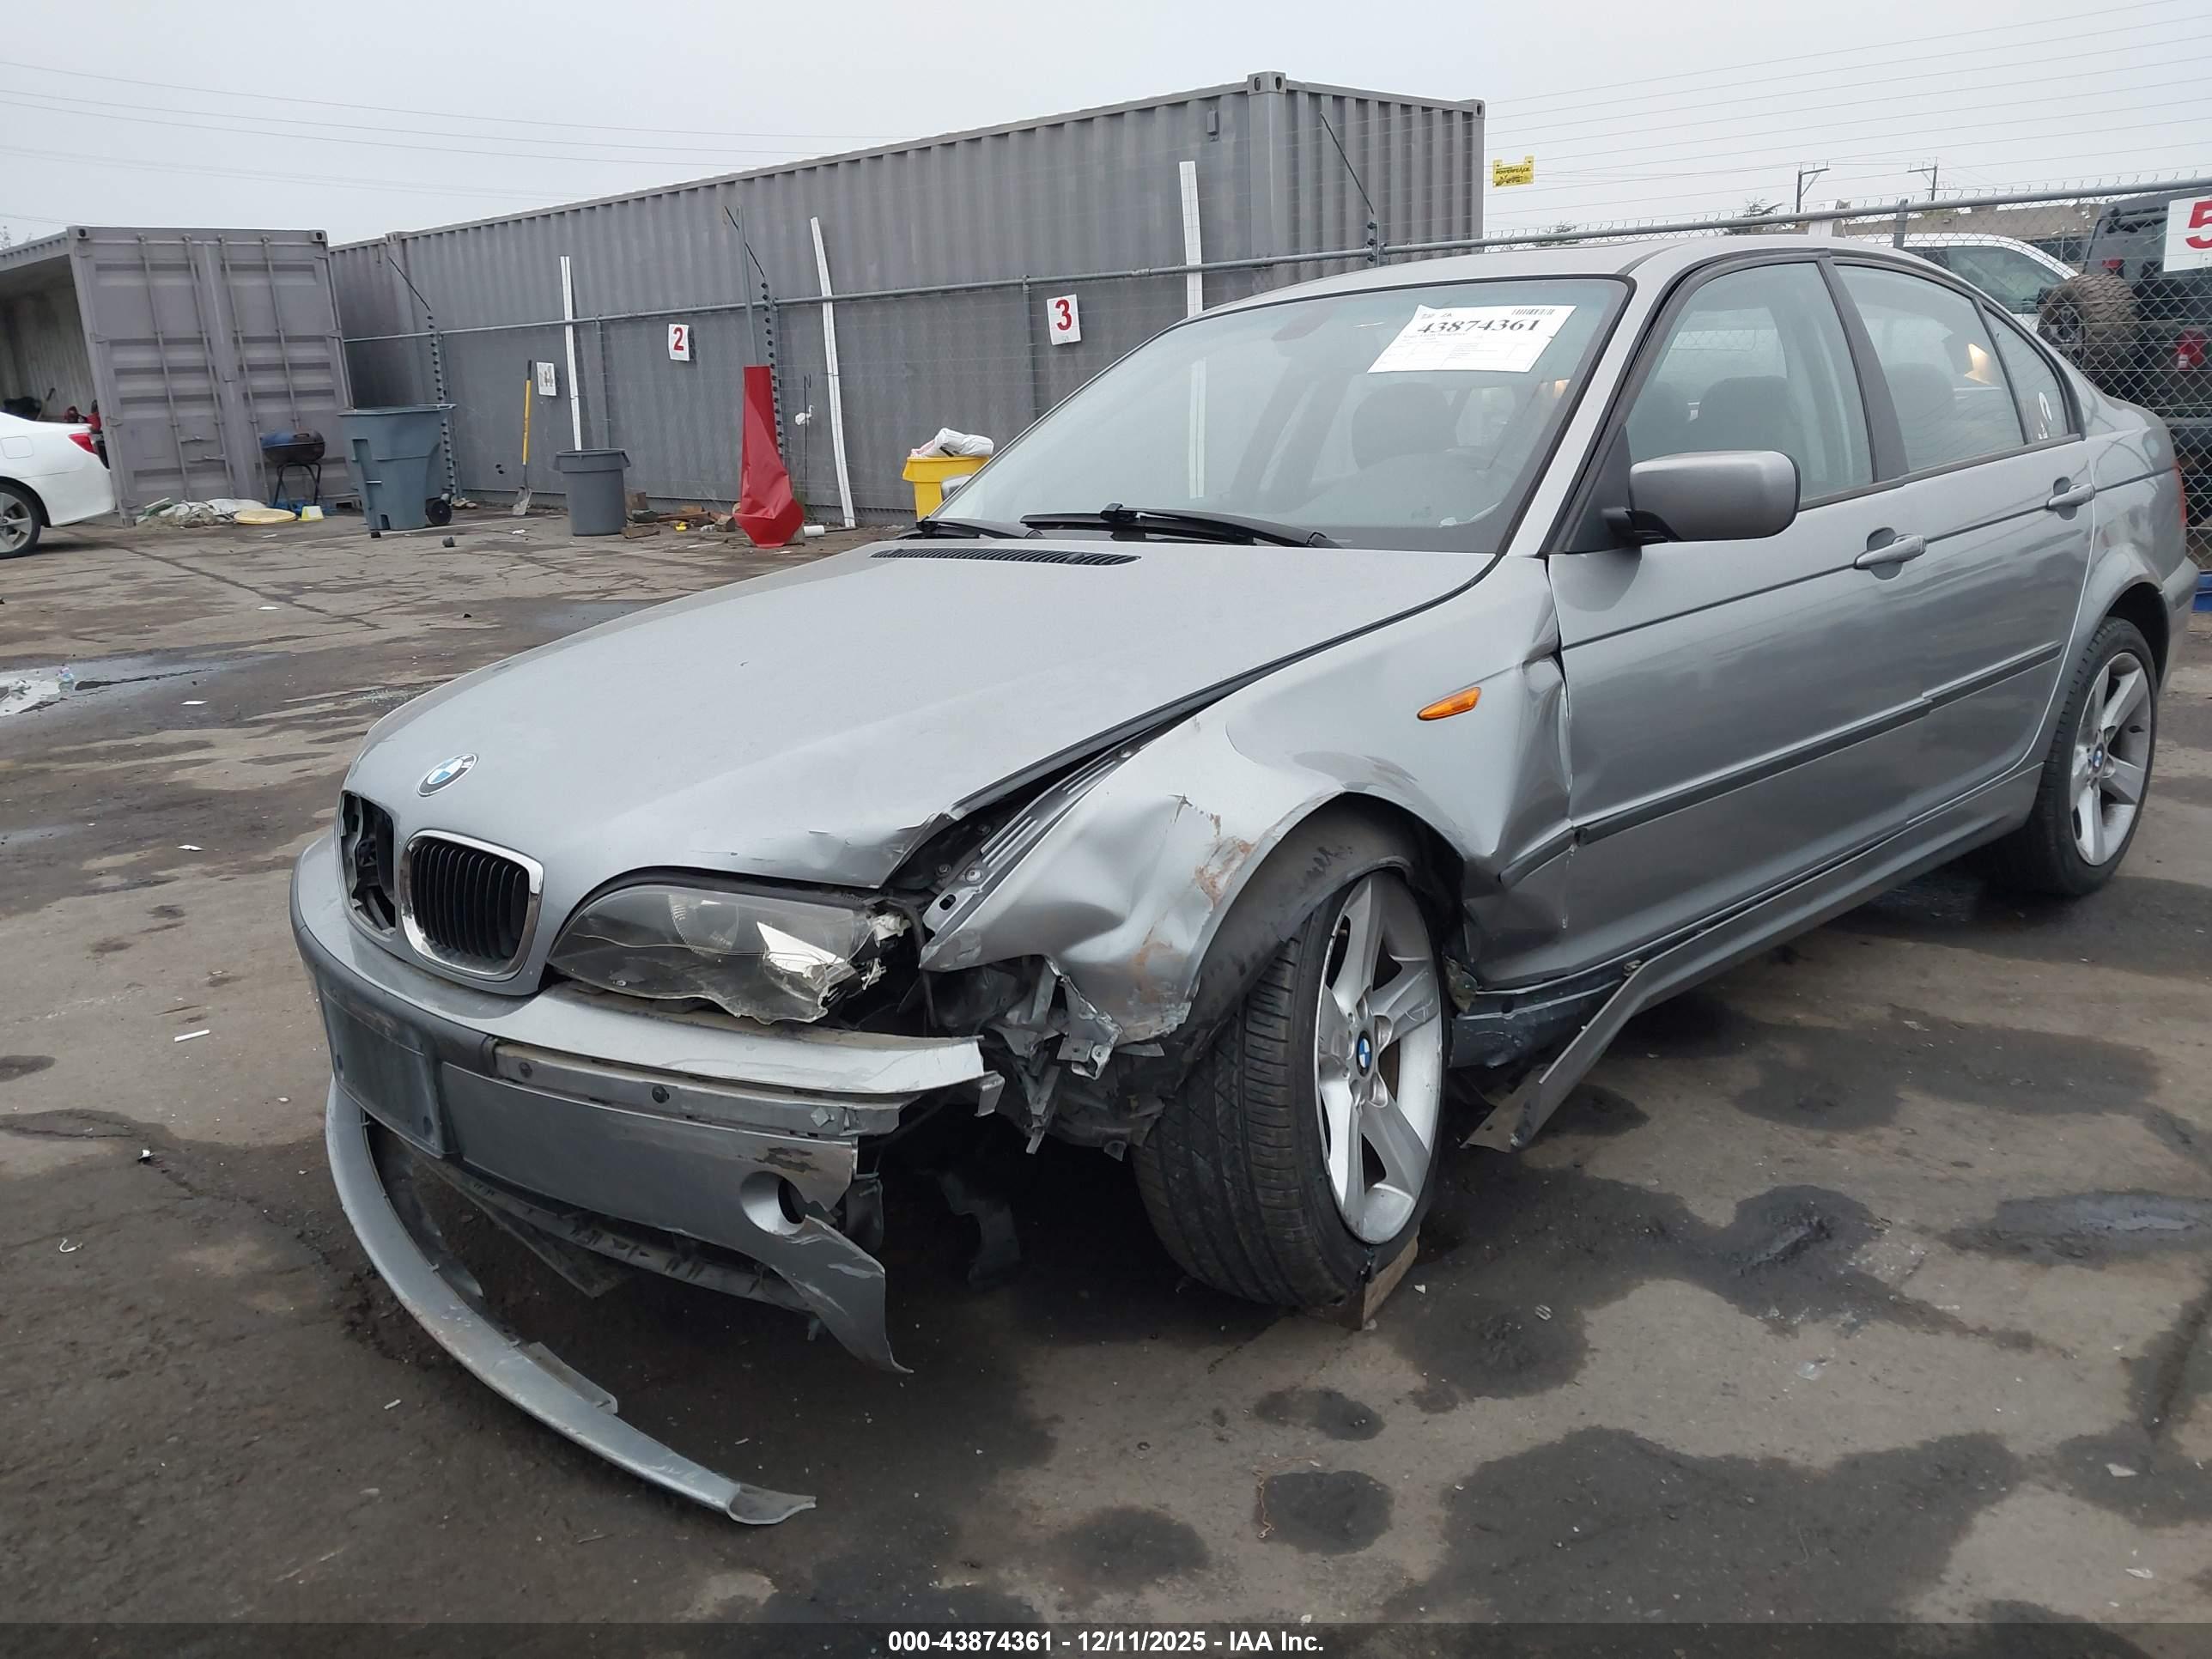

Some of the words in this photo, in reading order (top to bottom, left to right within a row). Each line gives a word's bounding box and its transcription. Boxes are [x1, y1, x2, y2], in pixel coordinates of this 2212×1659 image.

[1054, 298, 1073, 331] 3
[1417, 318, 1541, 334] 43874361
[672, 326, 685, 351] 2
